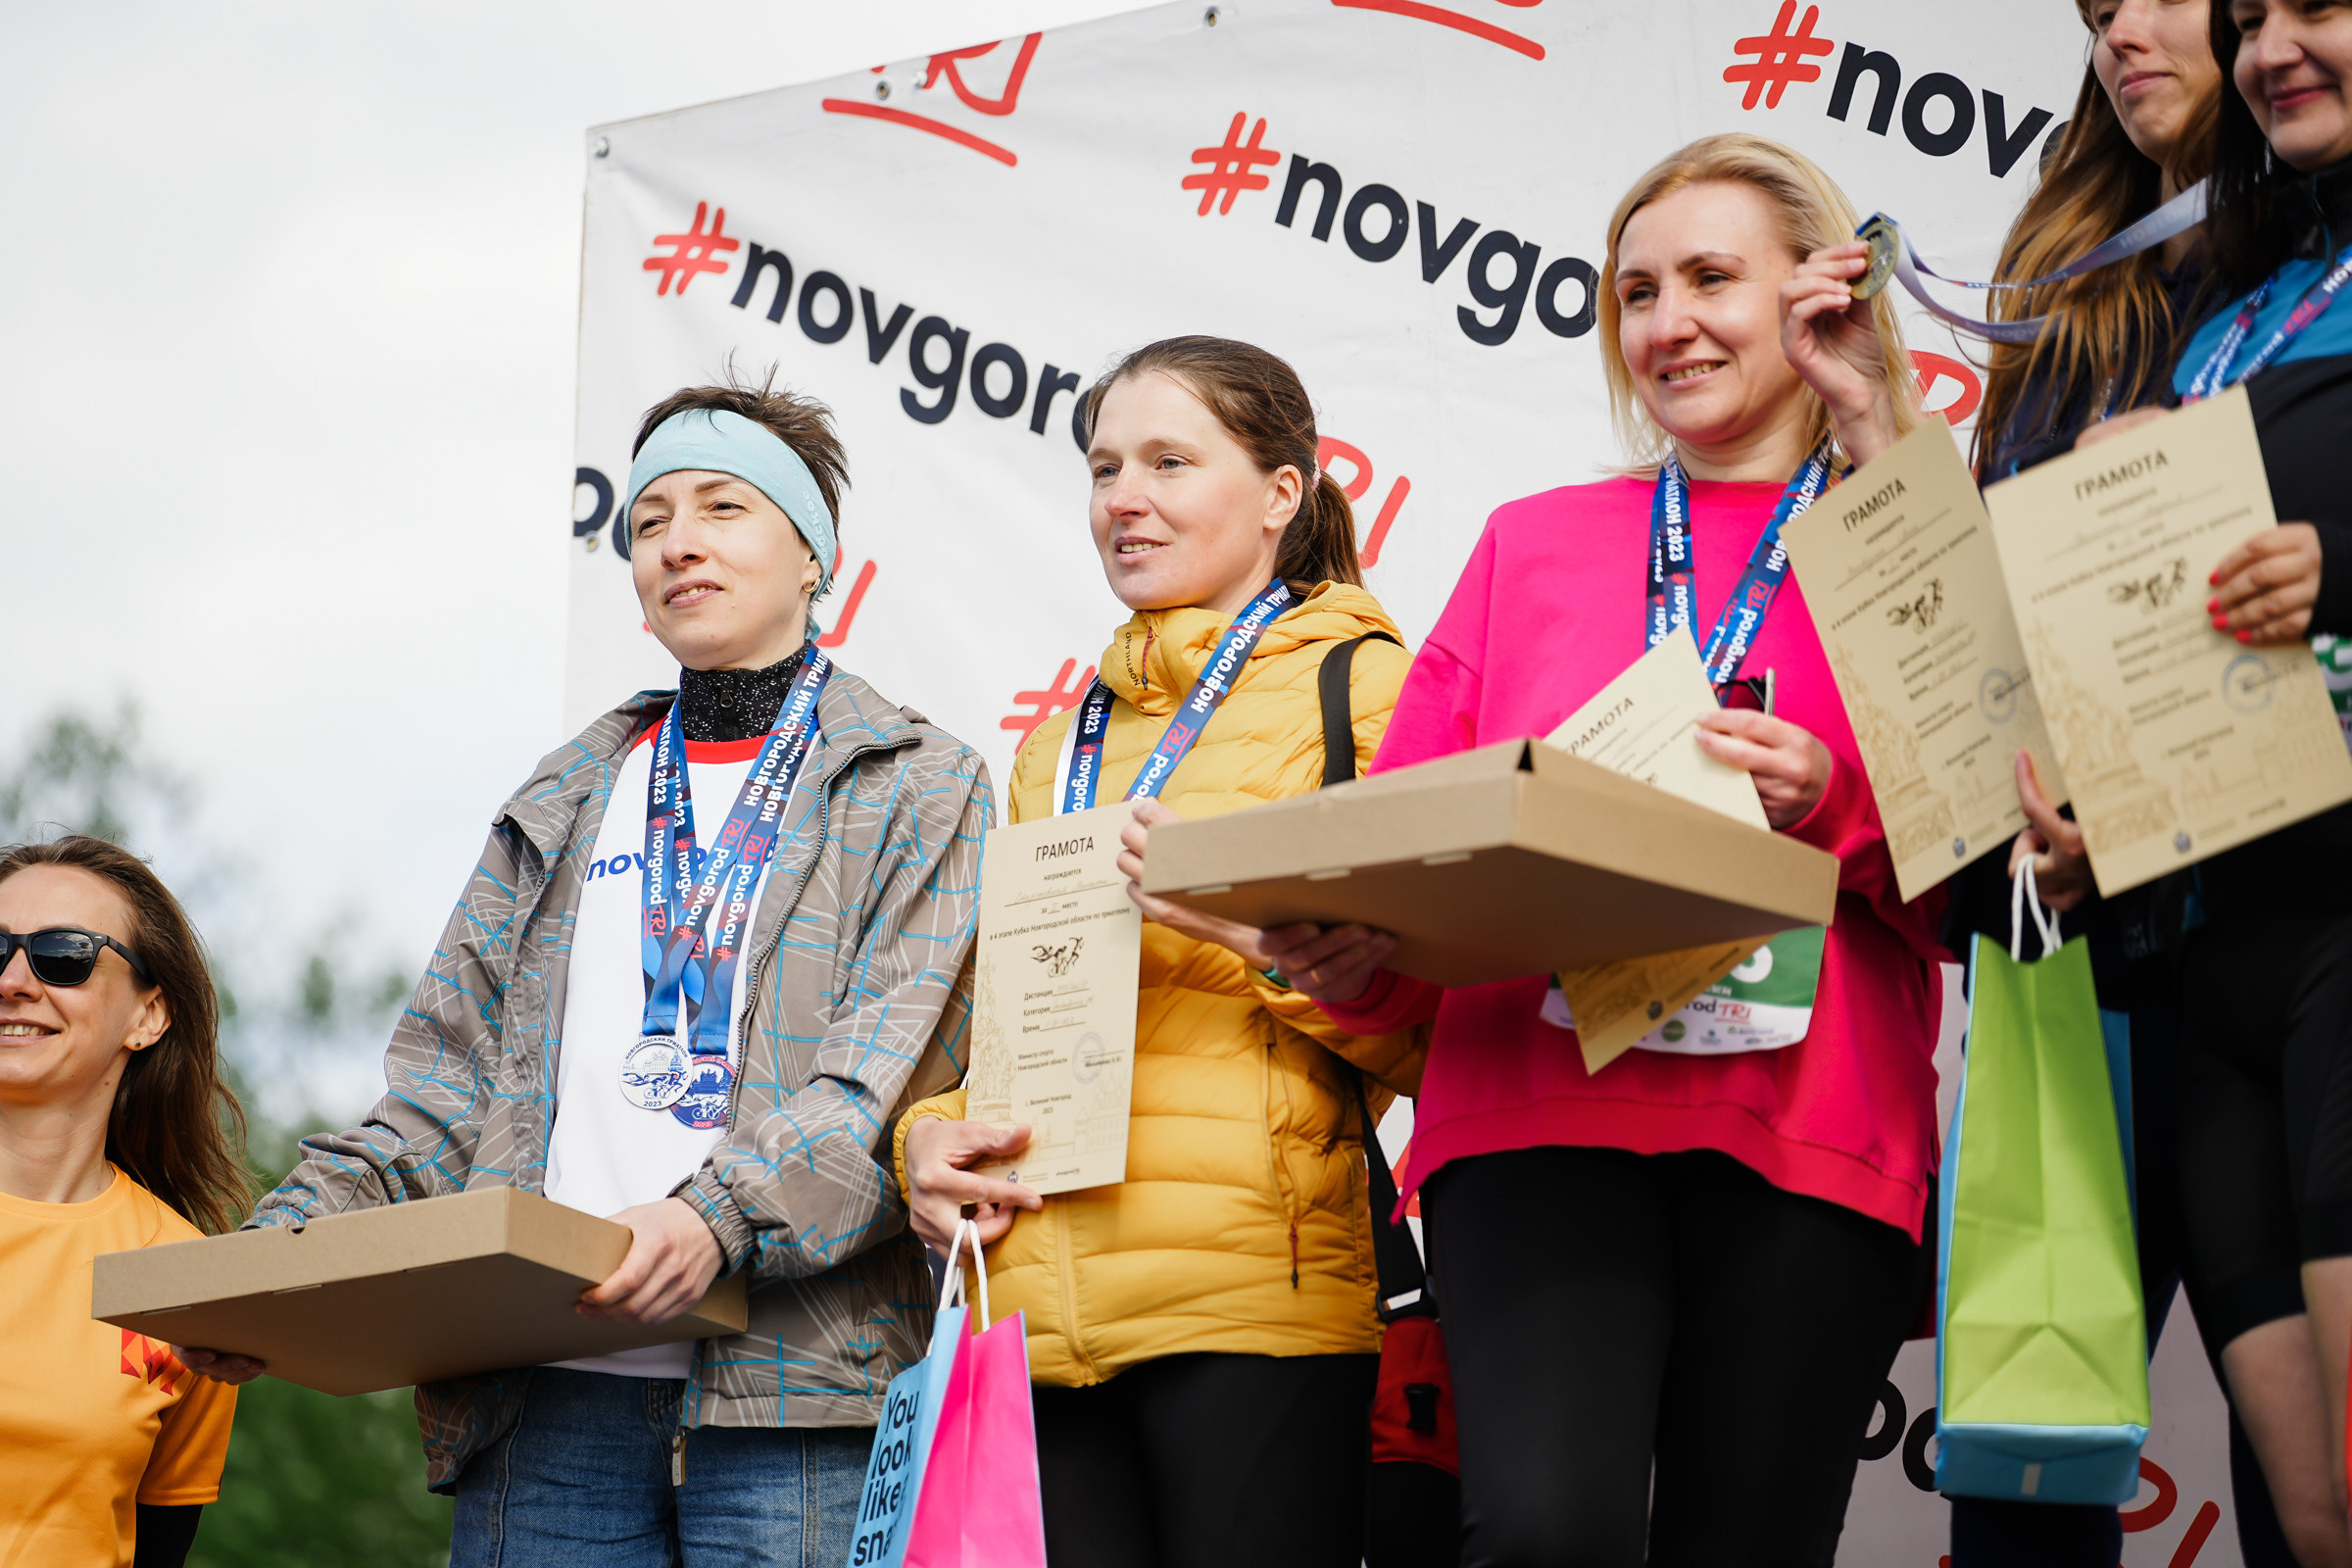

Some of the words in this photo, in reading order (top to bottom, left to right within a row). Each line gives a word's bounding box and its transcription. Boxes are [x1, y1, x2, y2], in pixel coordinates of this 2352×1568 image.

[2074, 450, 2169, 502] ГРАМОТА
[1842, 477, 1907, 533] ГРАМОТА
[1667, 524, 1686, 563] 2023
[1125, 631, 1141, 687] NORTHLAND
[1191, 600, 1273, 713] НОВГОРОДСКИЙ
[1084, 706, 1103, 735] 2023
[743, 686, 813, 808] НОВГОРОДСКИЙ
[653, 768, 668, 806] 2023
[1035, 836, 1095, 862] ГРАМОТА
[1044, 867, 1082, 882] награждается
[1061, 901, 1079, 910] место
[1013, 926, 1030, 937] Кубка
[1031, 918, 1069, 932] Новгородской
[624, 1037, 666, 1060] НОВГОРОДСКИЙ
[885, 1391, 920, 1434] You
[871, 1425, 913, 1480] look
[862, 1477, 902, 1524] like
